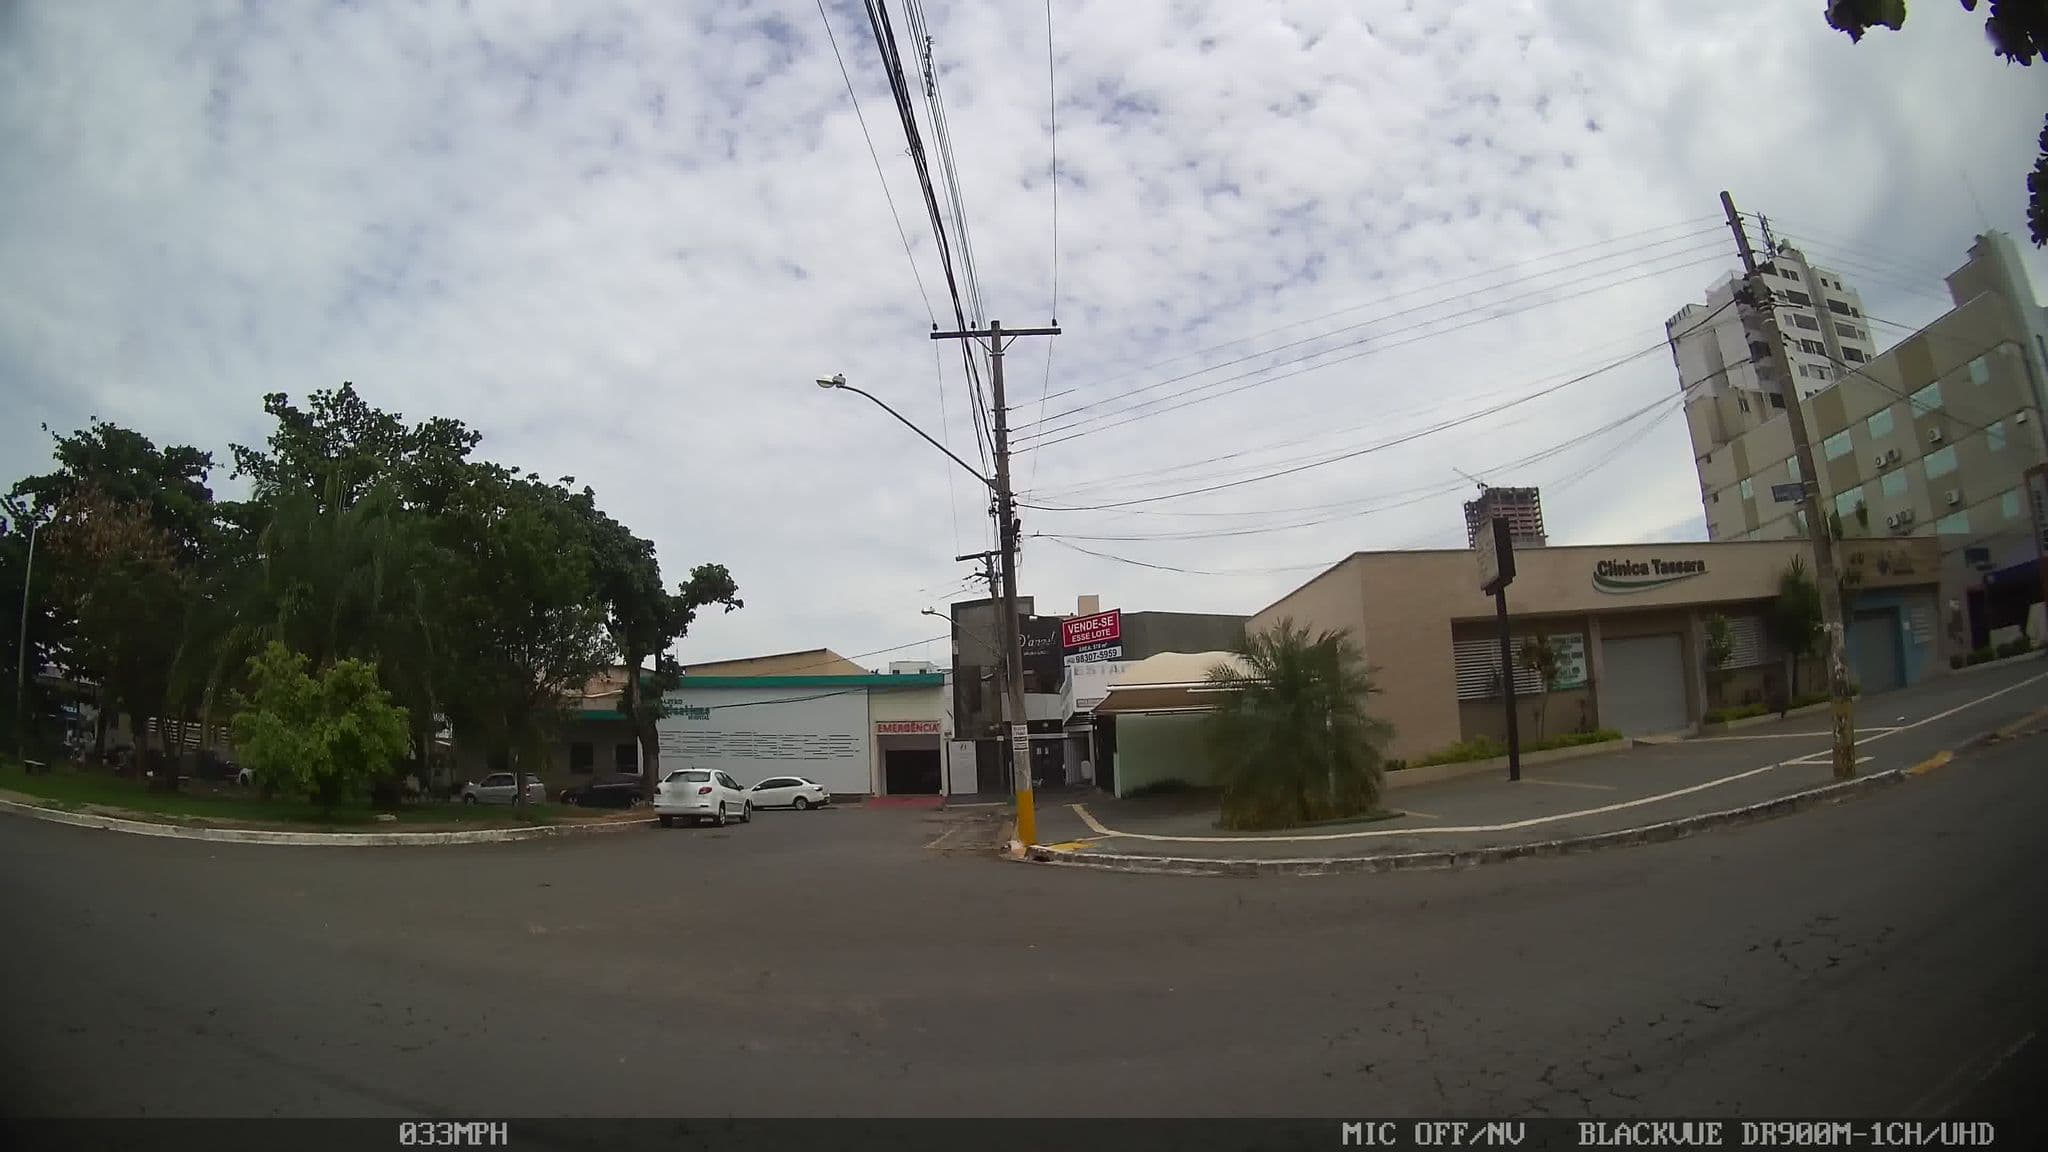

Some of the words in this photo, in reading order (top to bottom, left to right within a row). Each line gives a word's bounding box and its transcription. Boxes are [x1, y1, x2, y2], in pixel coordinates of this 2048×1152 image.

[1597, 559, 1649, 576] Clínica
[1068, 615, 1114, 634] VENDE-SE
[1071, 632, 1090, 642] ESSE
[1091, 628, 1111, 639] LOTE
[1075, 648, 1118, 664] 98307-5959
[877, 722, 940, 733] EMERGÊNCIA
